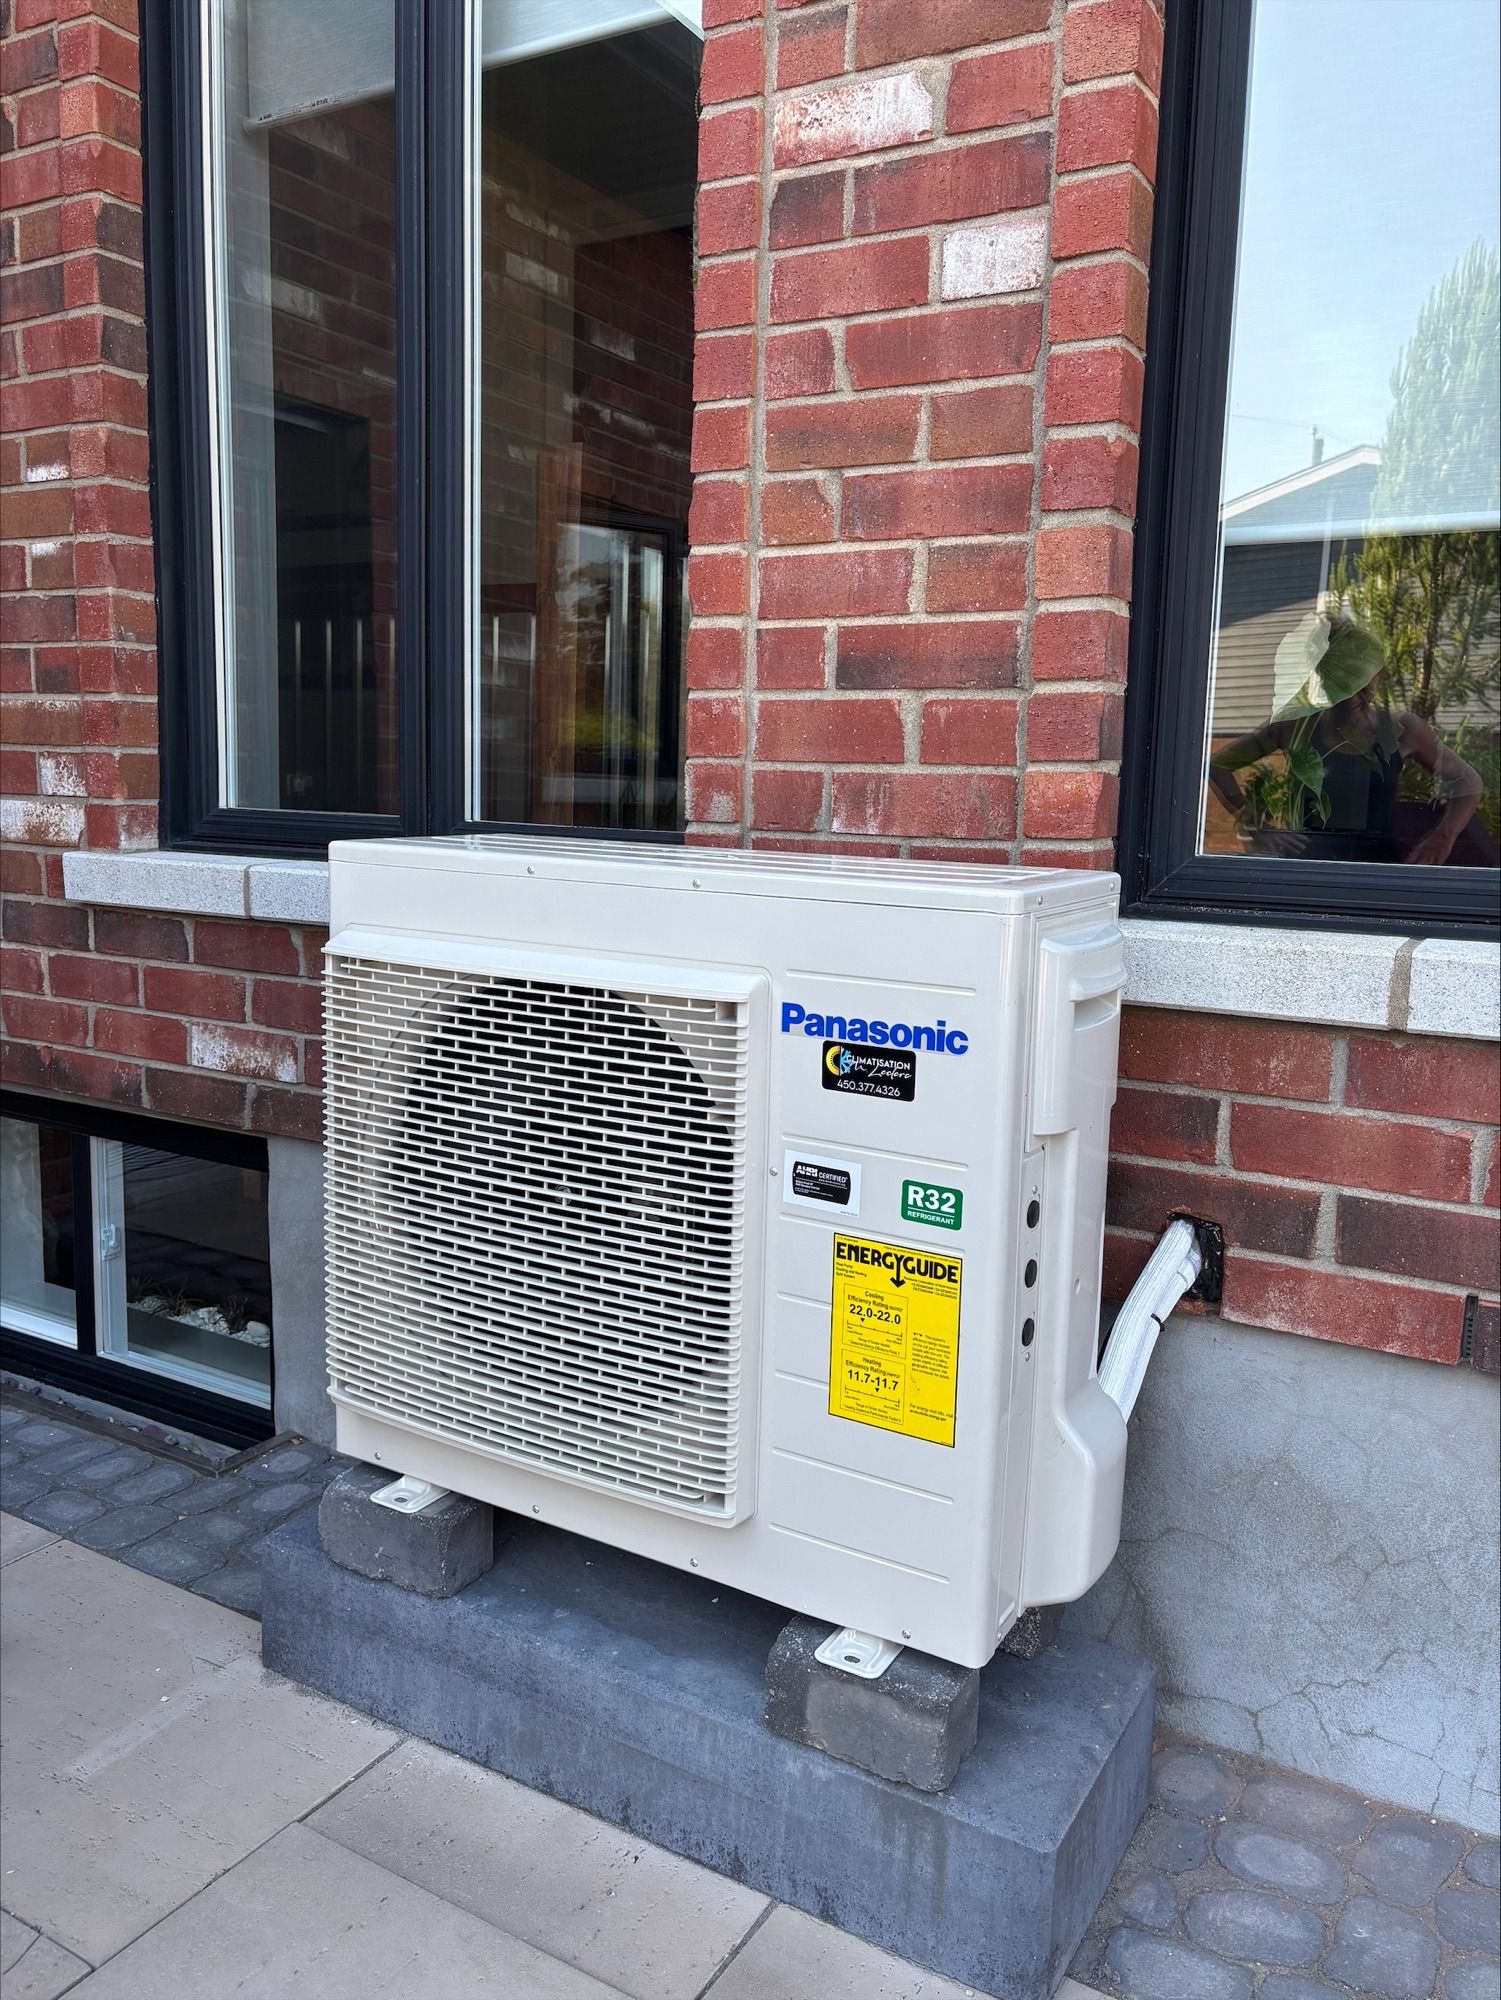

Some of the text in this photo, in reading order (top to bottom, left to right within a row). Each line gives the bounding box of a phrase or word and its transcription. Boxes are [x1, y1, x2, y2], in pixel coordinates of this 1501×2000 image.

[781, 1002, 969, 1056] Panasonic
[846, 1055, 911, 1070] CLIMATISATION
[837, 1079, 901, 1097] 450.377.4326
[908, 1185, 956, 1214] R32
[907, 1210, 955, 1225] REFRIGERANT
[836, 1241, 959, 1285] ENERGYGUIDE
[848, 1294, 871, 1306] Efficiency
[873, 1300, 888, 1310] Rating
[865, 1291, 884, 1302] Cooling
[850, 1303, 901, 1325] 22.0-22.0
[846, 1360, 869, 1371] Efficiency
[870, 1366, 886, 1376] Rating
[863, 1357, 881, 1367] Heating
[848, 1369, 899, 1391] 11.7-11.7
